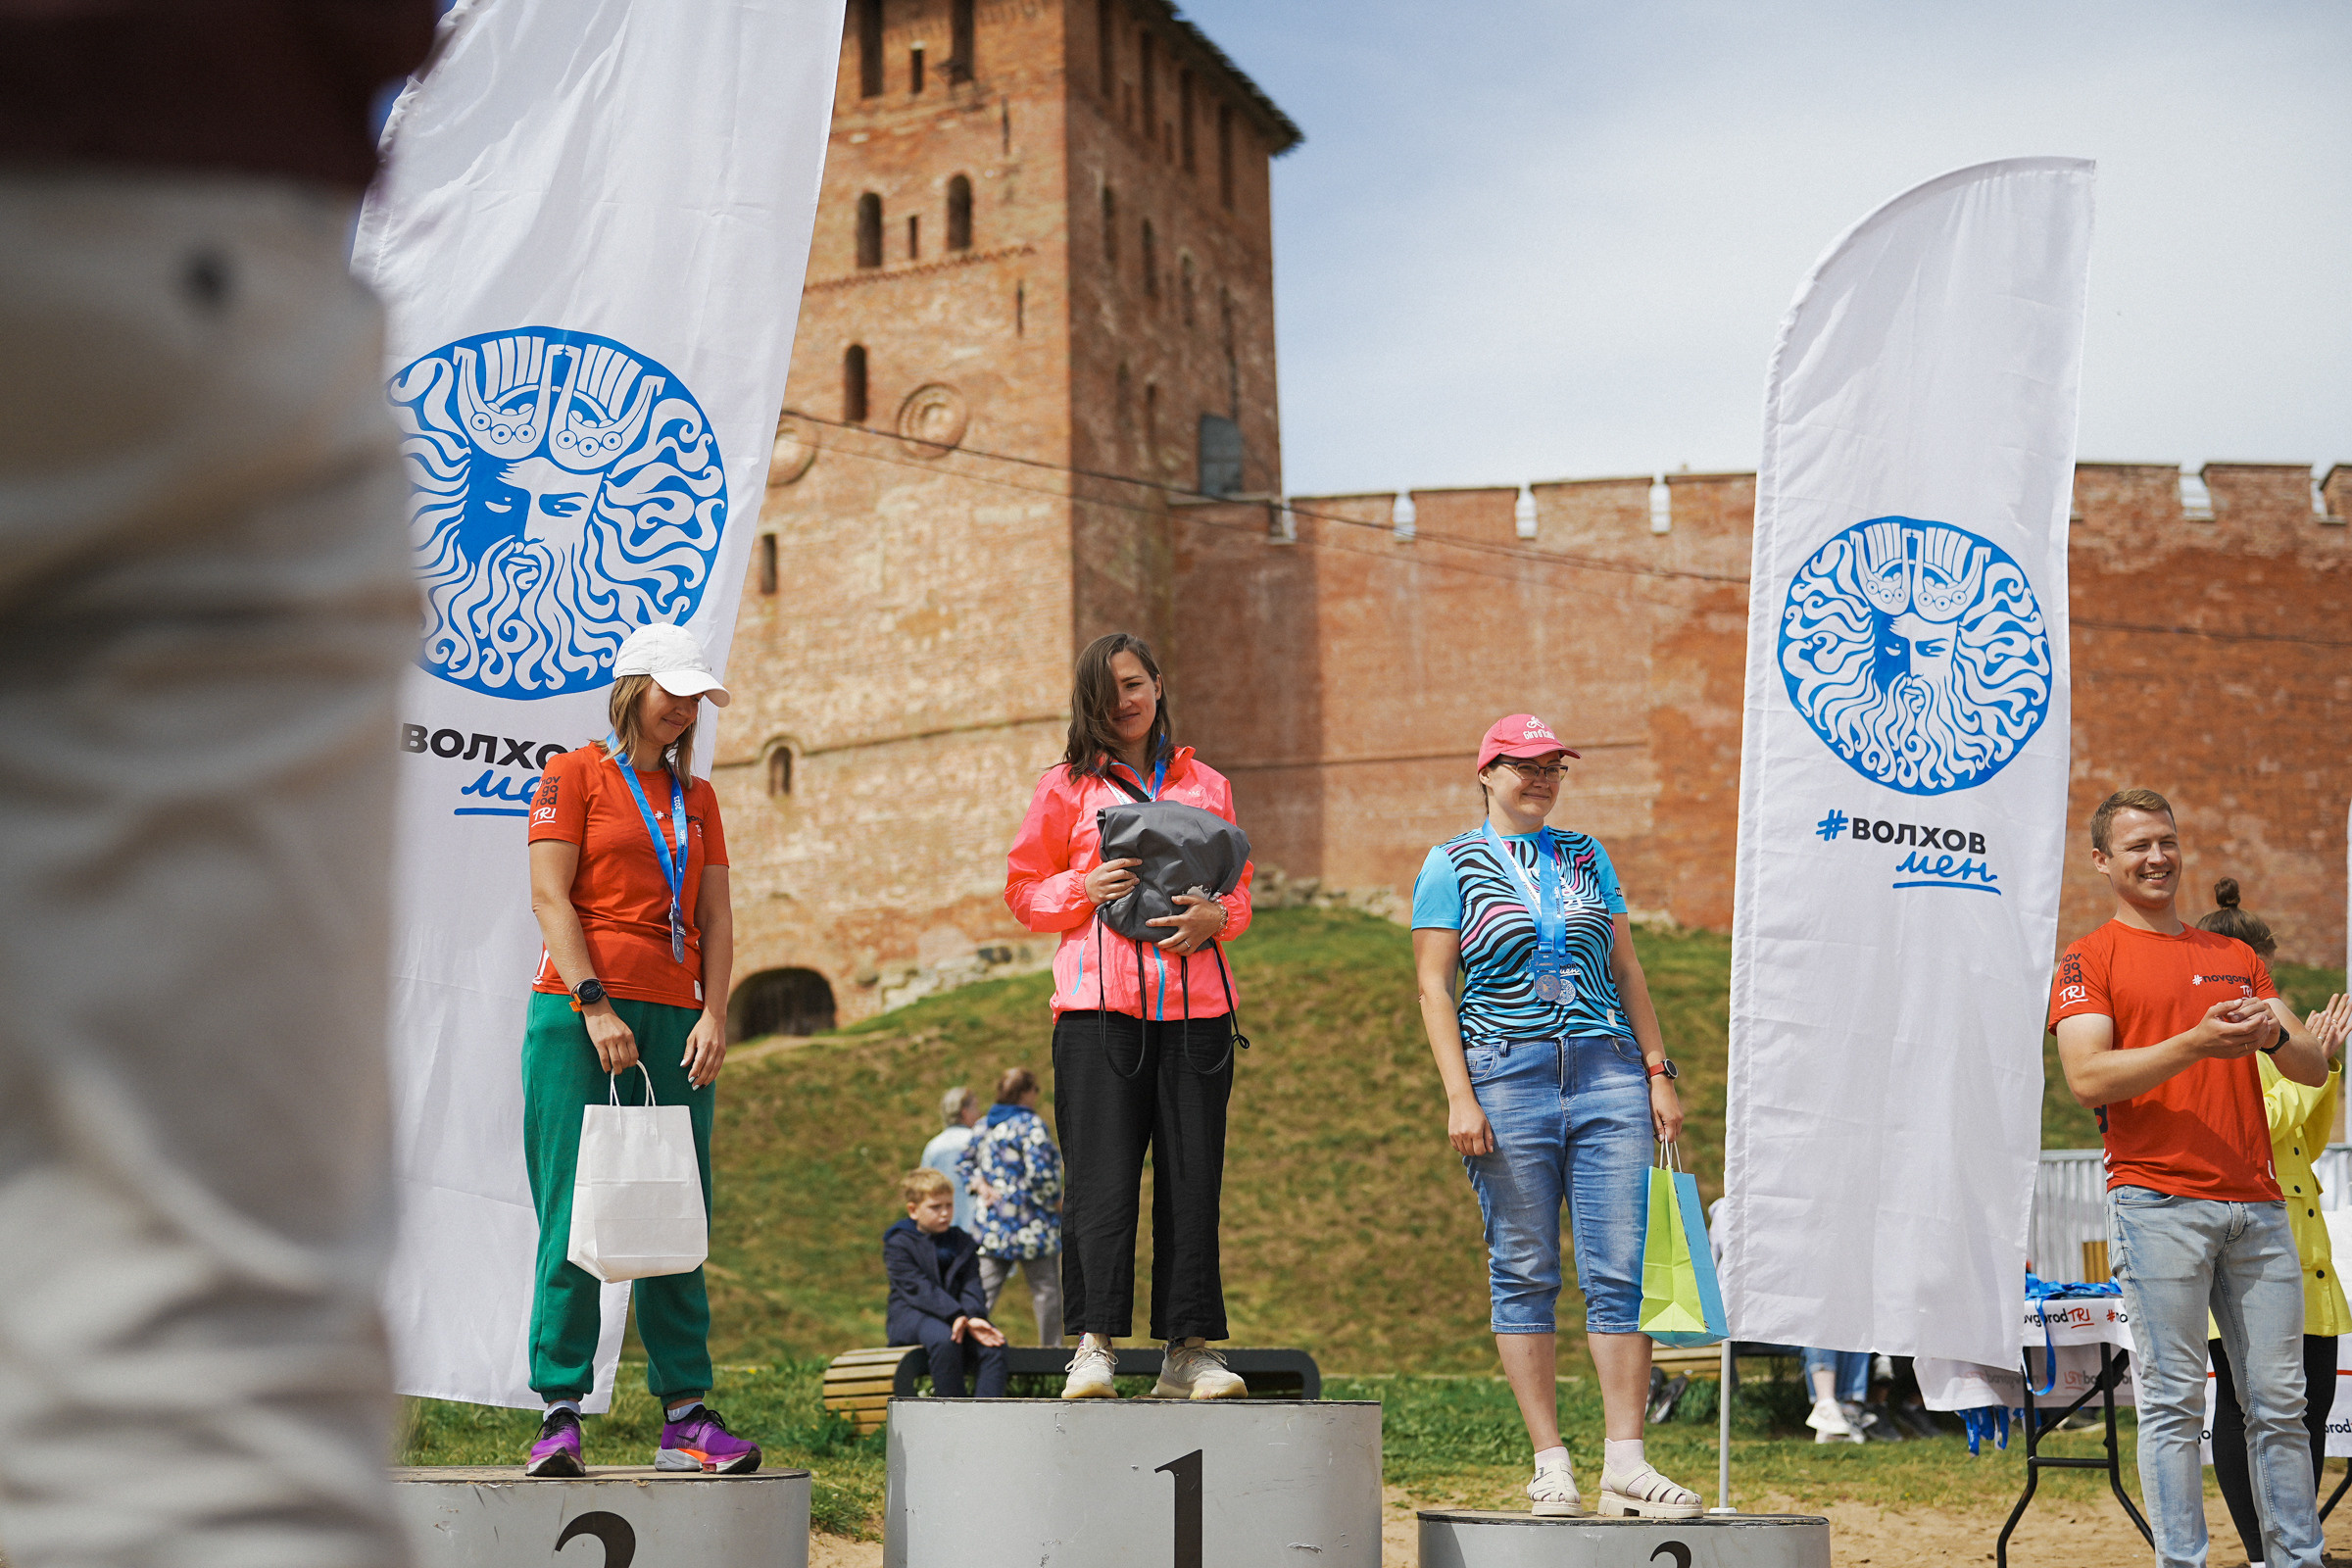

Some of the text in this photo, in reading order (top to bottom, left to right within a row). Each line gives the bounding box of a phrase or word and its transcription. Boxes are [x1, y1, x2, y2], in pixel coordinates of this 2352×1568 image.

[541, 785, 559, 797] go
[535, 793, 558, 807] rod
[532, 807, 557, 821] TRI
[1895, 851, 1998, 883] мен
[2063, 961, 2081, 975] go
[2059, 969, 2082, 987] rod
[2059, 985, 2085, 1002] TRI
[1154, 1448, 1203, 1568] 1
